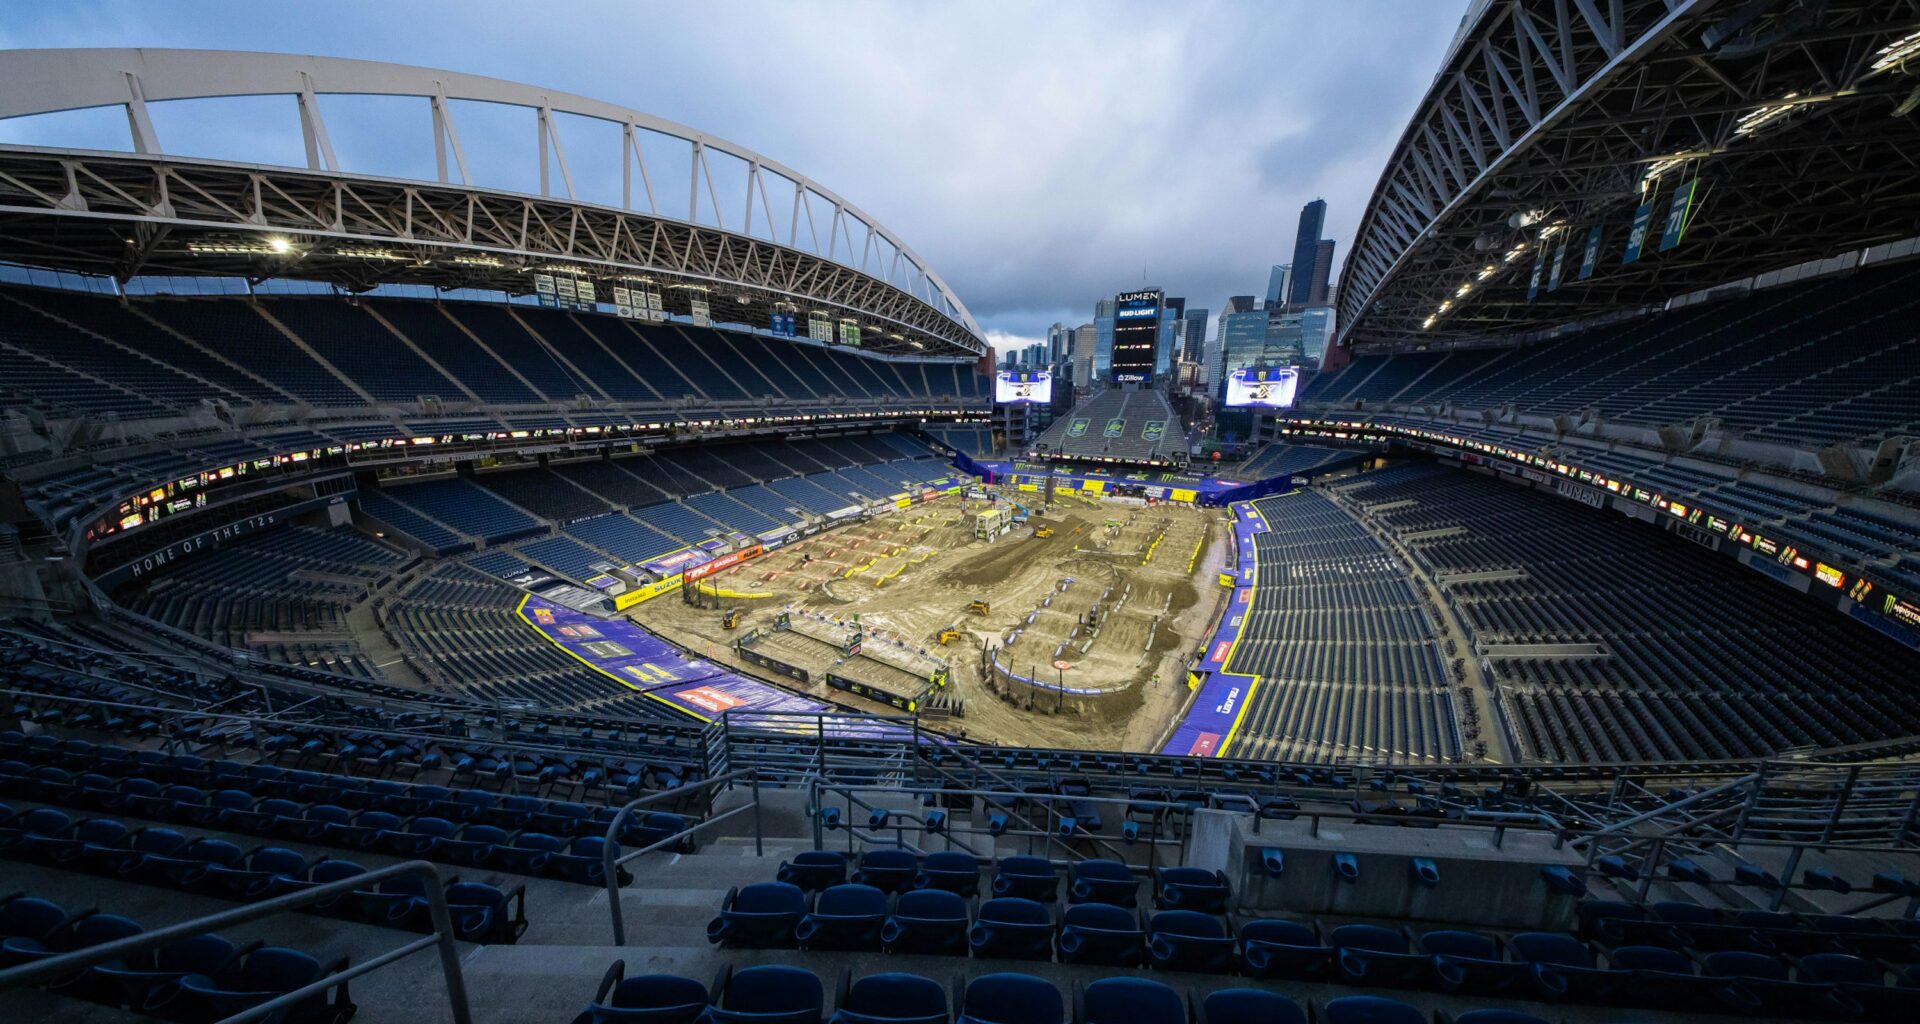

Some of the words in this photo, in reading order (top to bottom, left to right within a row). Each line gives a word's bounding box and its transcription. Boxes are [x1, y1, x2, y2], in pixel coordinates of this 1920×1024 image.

[1666, 210, 1683, 236] 71
[1629, 226, 1642, 249] 96
[1120, 292, 1159, 301] LUMEN
[1135, 308, 1155, 316] LIGHT
[1558, 480, 1601, 507] LUMEN
[132, 549, 175, 577] HOME
[183, 539, 203, 554] OF
[212, 525, 241, 543] THE
[249, 515, 275, 528] 12s
[1680, 526, 1714, 549] DELTA
[502, 567, 530, 580] LUMEN
